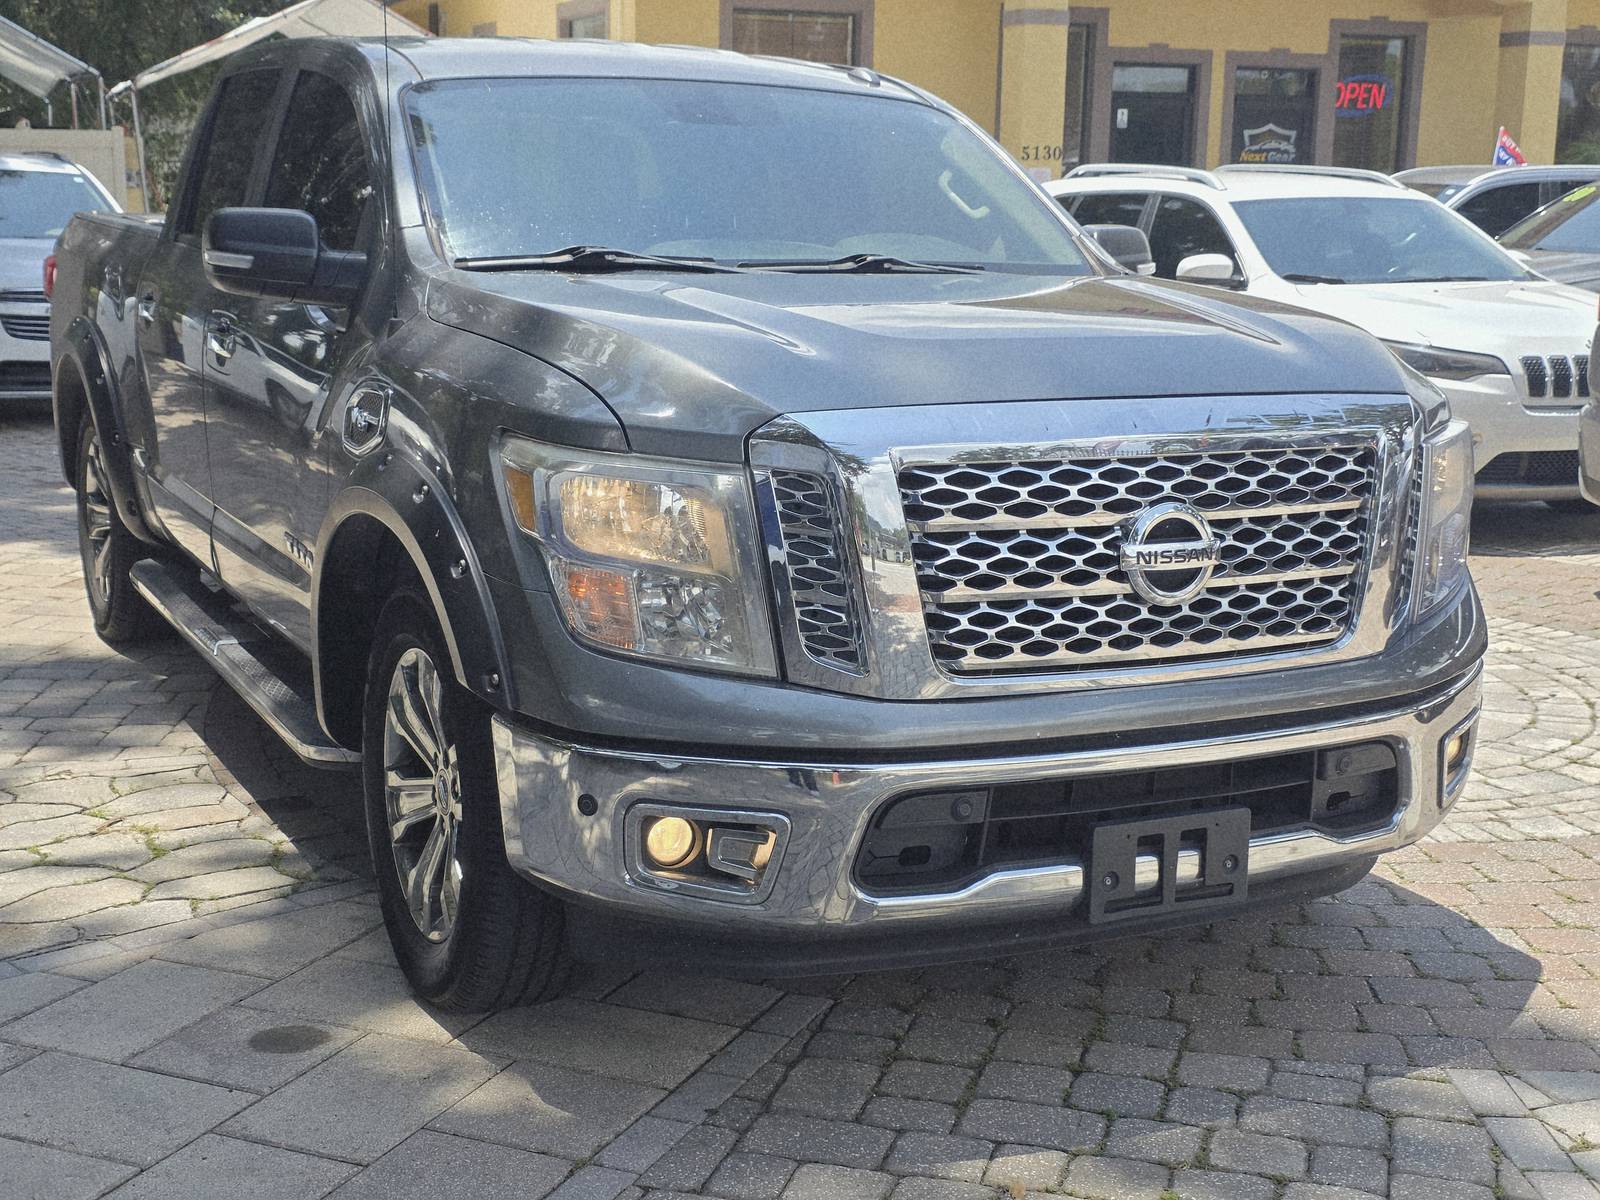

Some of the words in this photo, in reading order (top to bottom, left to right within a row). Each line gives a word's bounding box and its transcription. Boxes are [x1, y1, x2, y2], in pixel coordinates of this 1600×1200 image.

[1335, 81, 1386, 110] OPEN
[1021, 145, 1061, 160] 5130
[1239, 151, 1267, 162] Next
[1267, 151, 1296, 162] Gear
[1136, 546, 1214, 565] NISSAN
